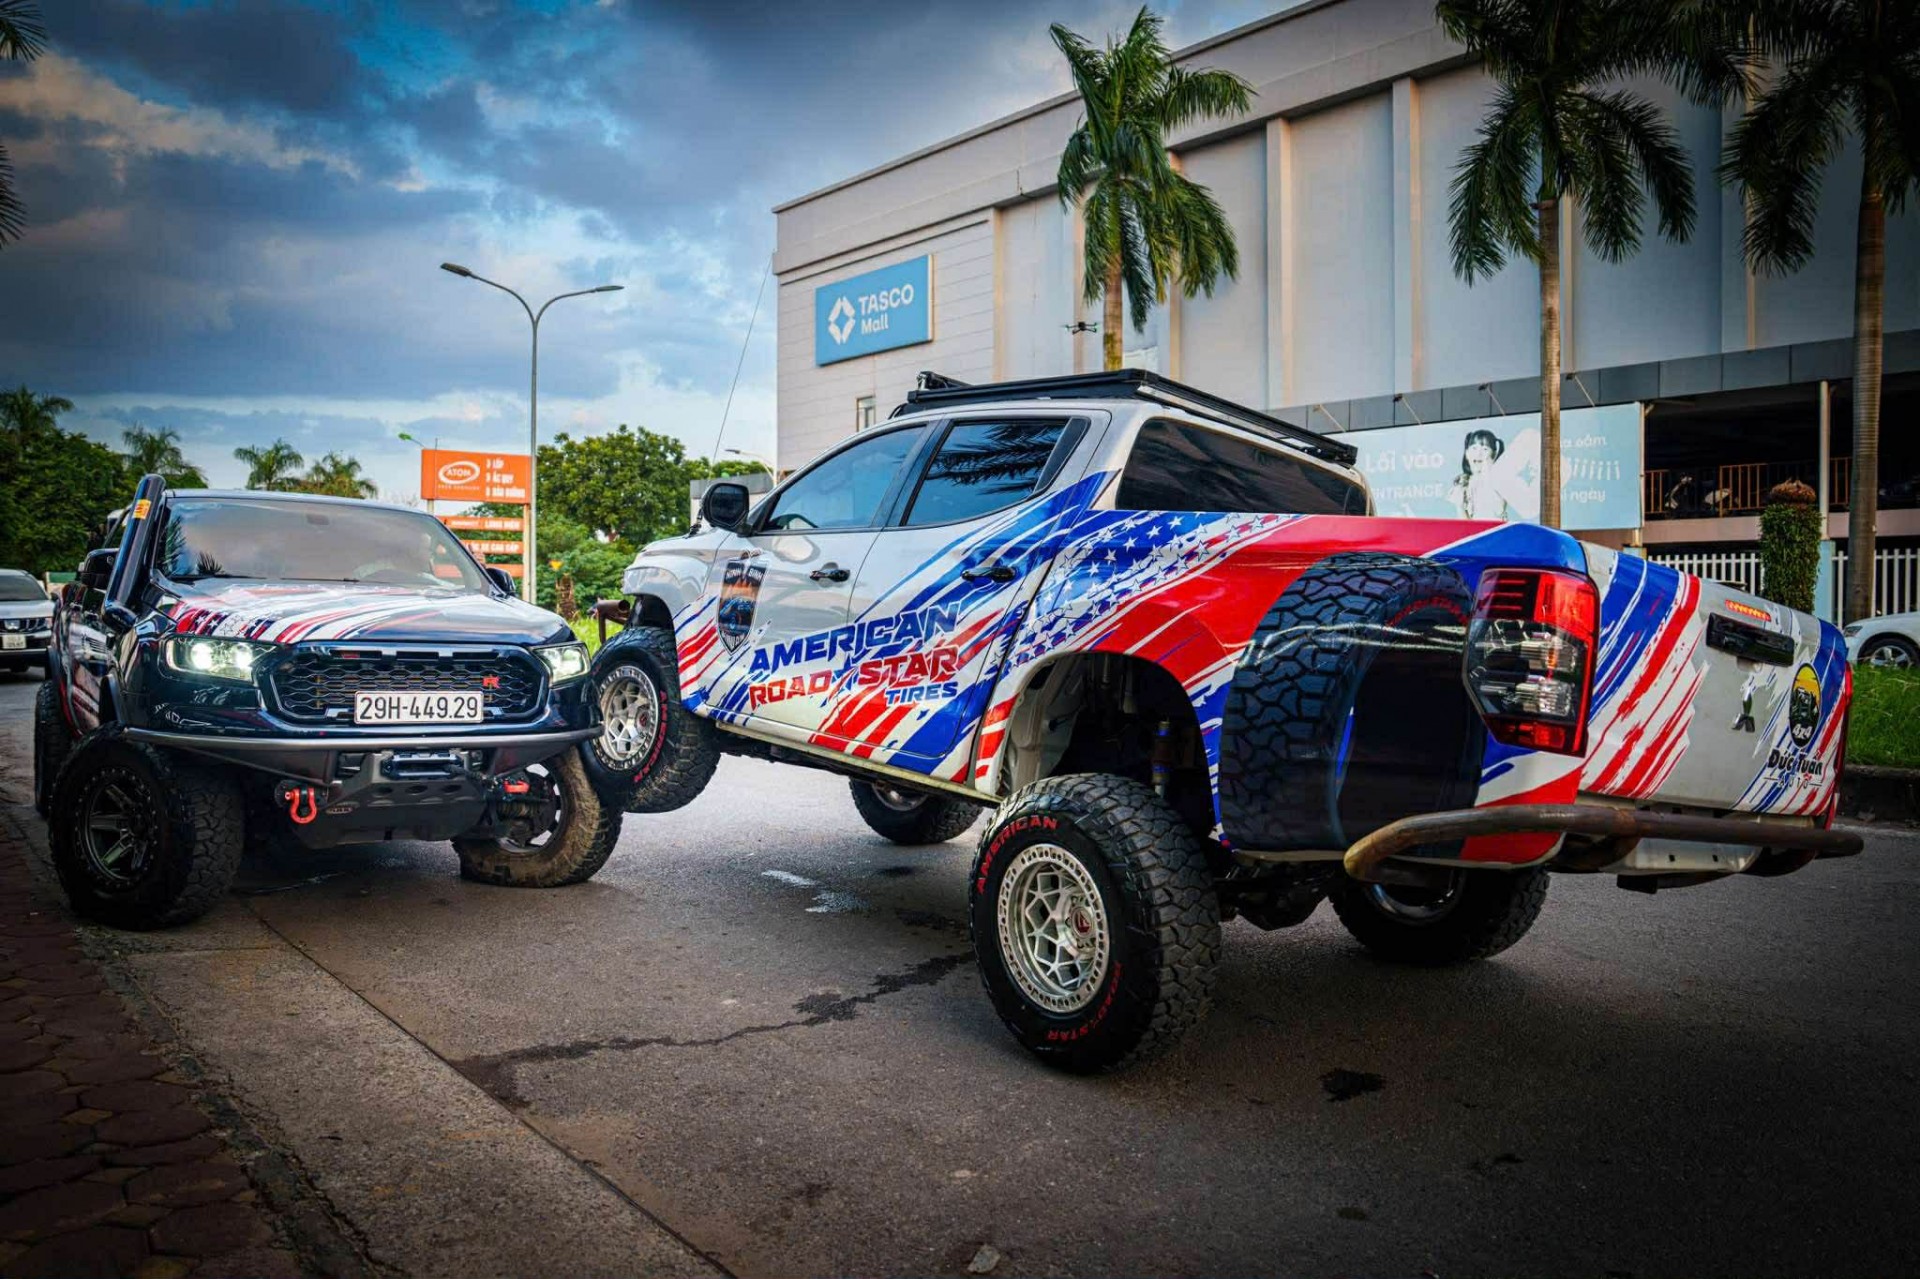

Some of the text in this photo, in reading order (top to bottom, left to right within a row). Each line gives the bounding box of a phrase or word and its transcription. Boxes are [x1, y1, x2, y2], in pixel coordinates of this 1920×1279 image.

[858, 283, 914, 316] TASCO
[861, 313, 889, 335] Mall
[748, 602, 958, 675] AMERICAN
[749, 645, 961, 712] ROAD STAR
[884, 680, 960, 706] TIRES
[359, 695, 479, 720] 29H-449.29
[1791, 723, 1813, 740] 4x4
[976, 814, 1058, 896] AMERICAN
[1047, 1024, 1089, 1041] STAR
